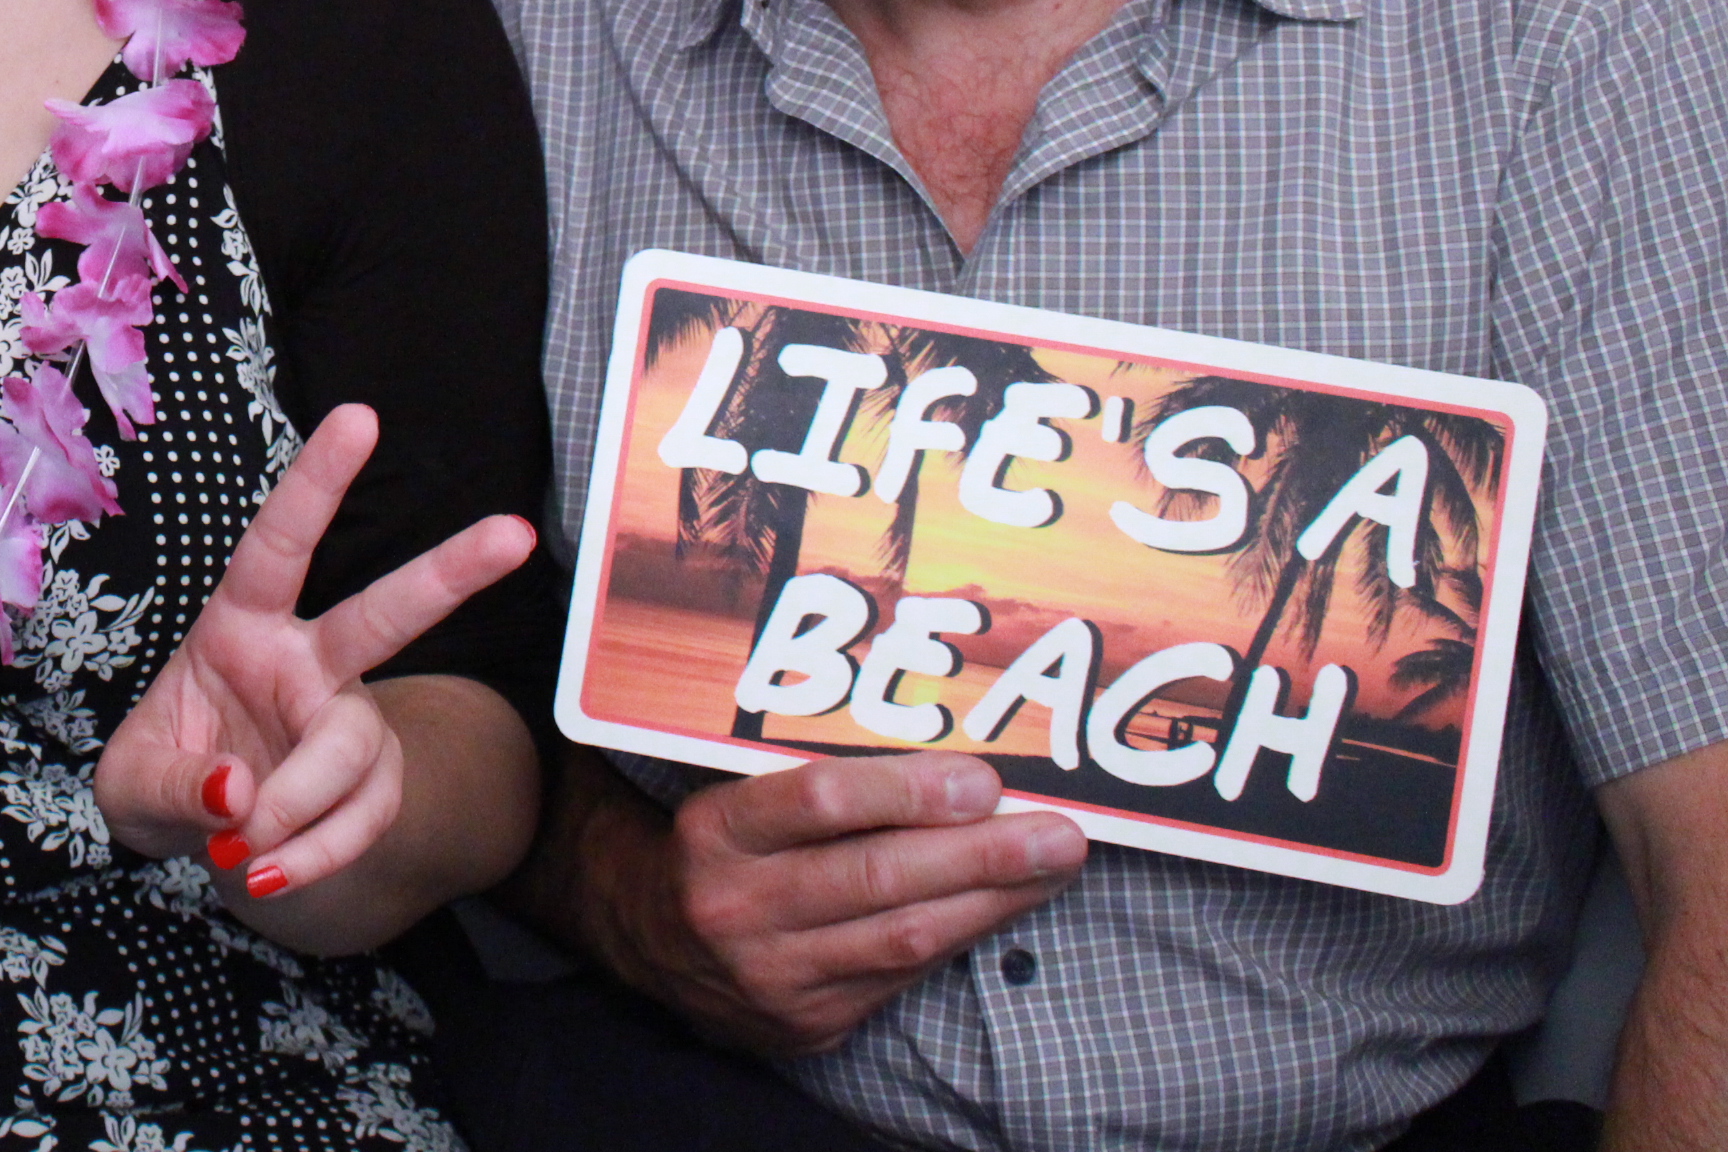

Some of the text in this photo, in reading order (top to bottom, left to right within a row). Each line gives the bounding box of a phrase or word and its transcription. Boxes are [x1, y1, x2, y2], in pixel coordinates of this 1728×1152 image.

[657, 326, 1428, 590] LIFE'S A
[734, 572, 1348, 802] BEACH
